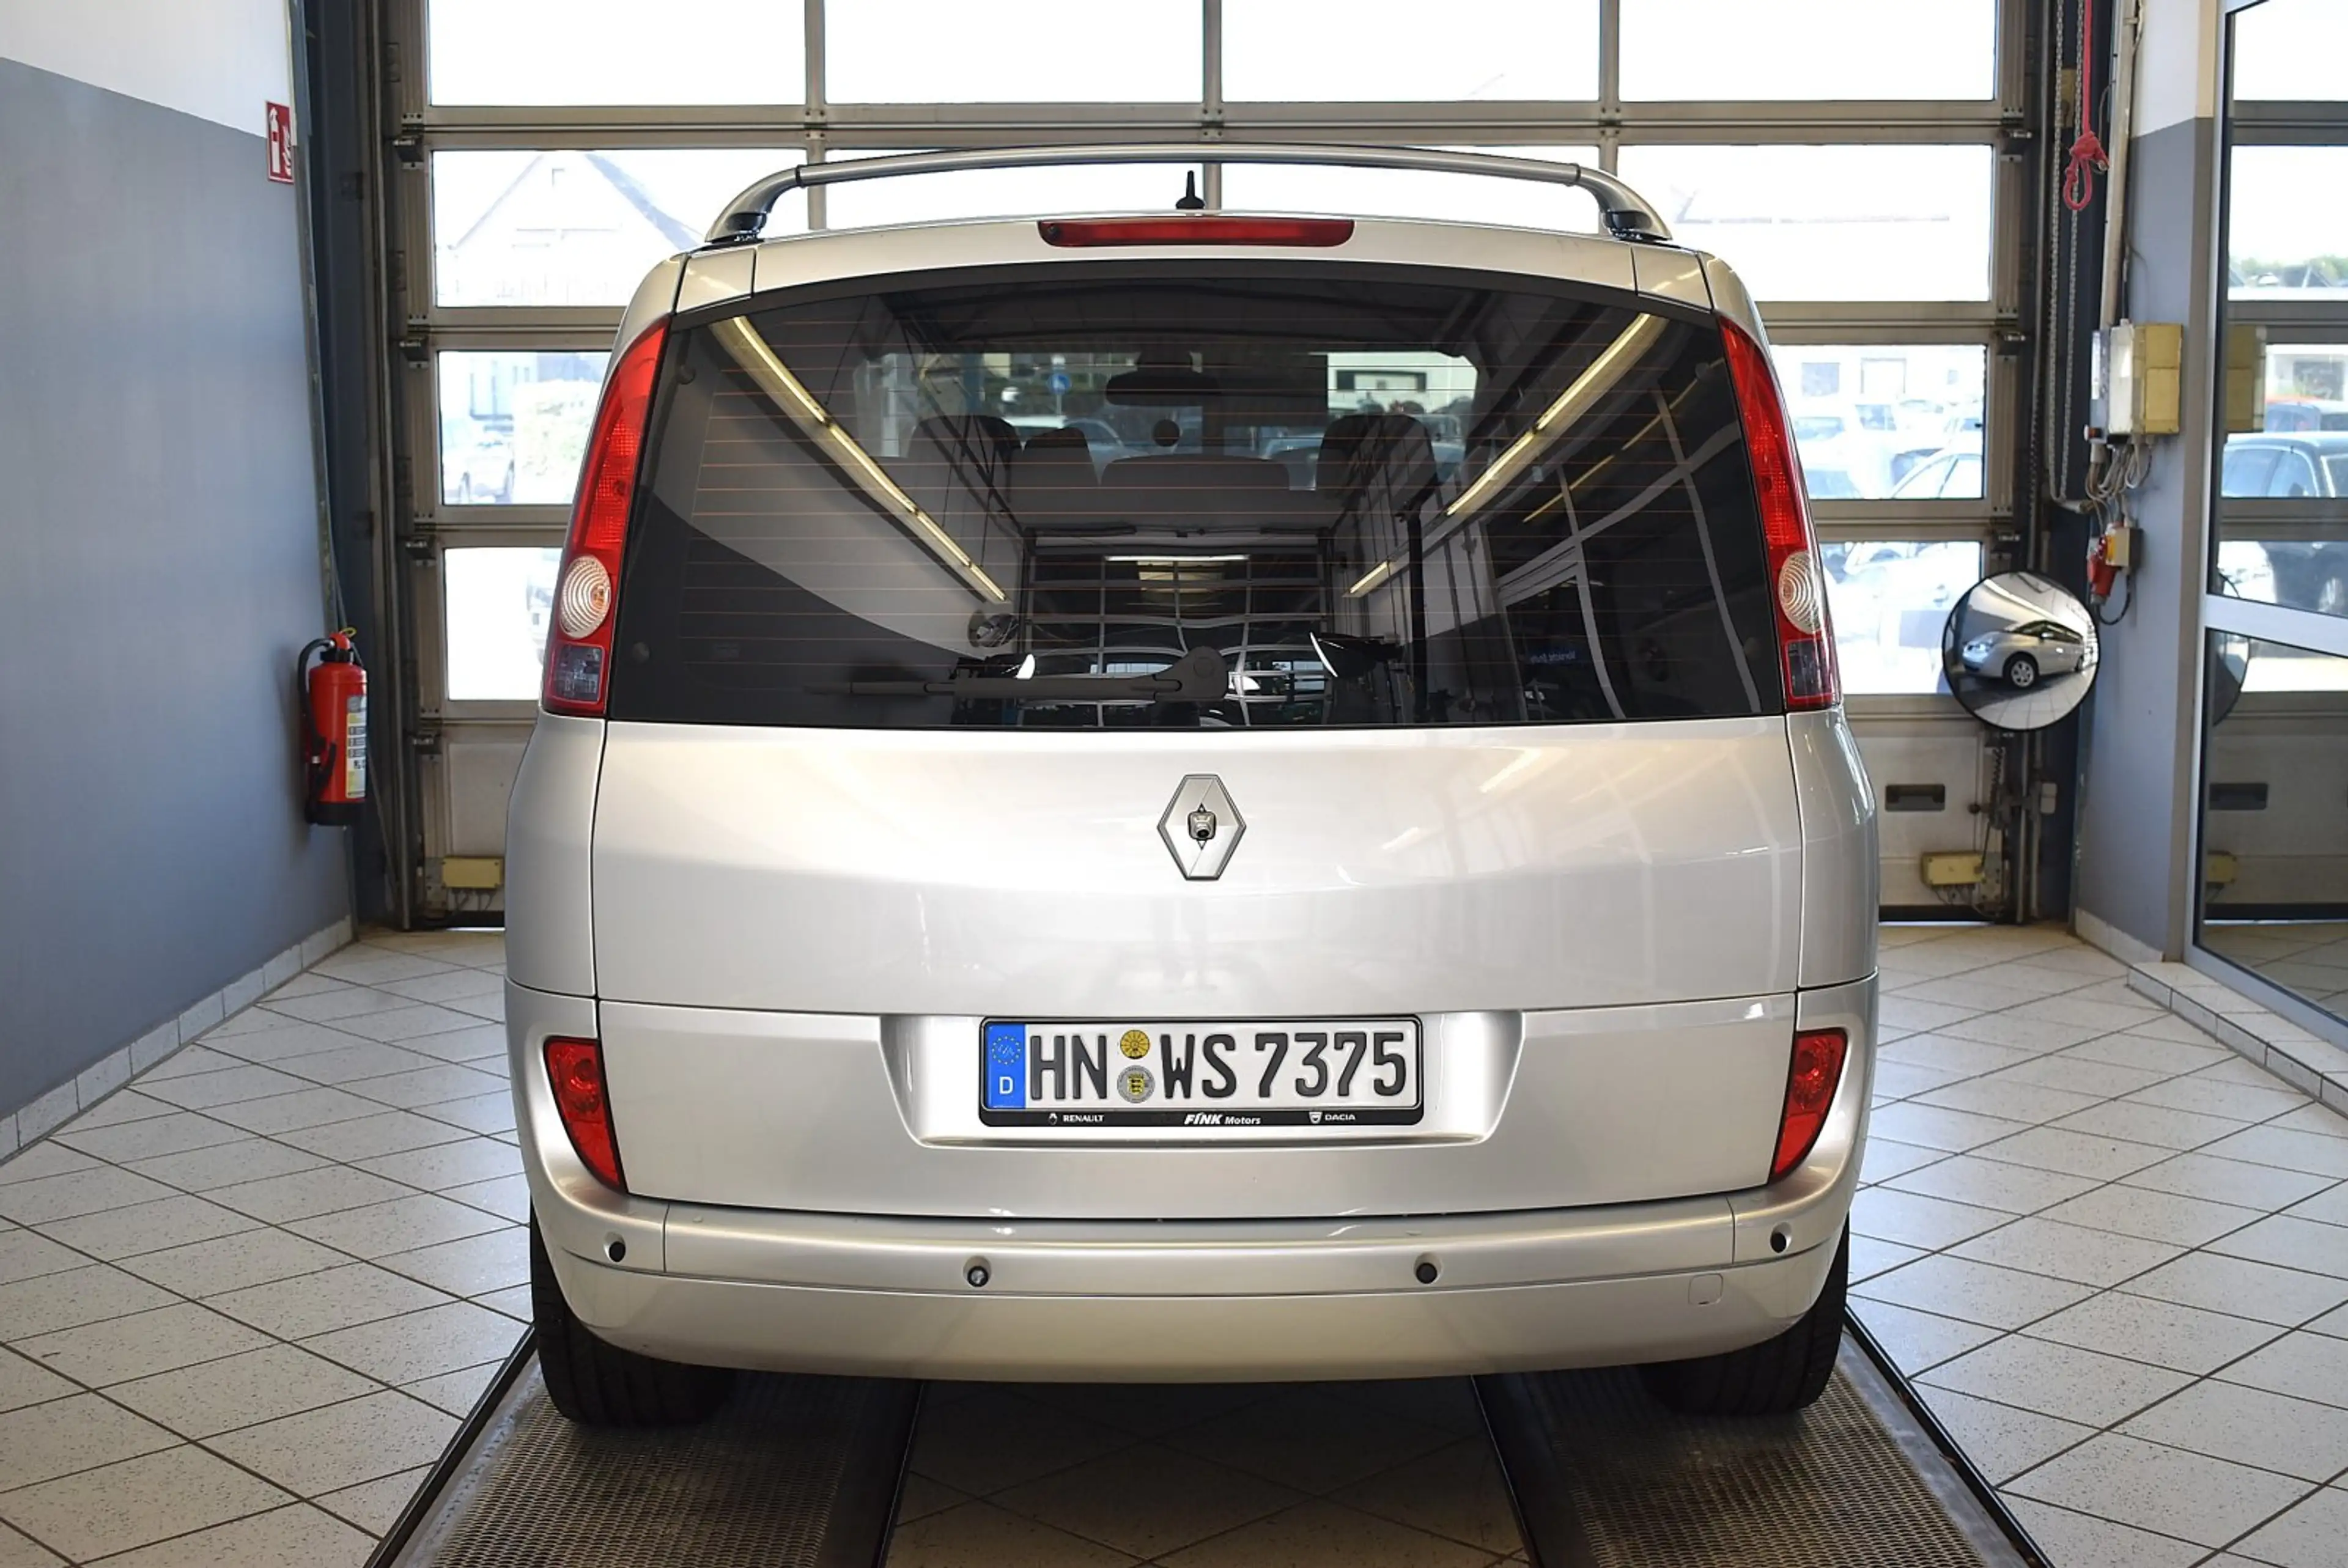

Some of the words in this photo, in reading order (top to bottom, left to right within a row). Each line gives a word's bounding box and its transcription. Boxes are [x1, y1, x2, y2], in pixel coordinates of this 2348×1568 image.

[1030, 1035, 1107, 1100] HN
[1161, 1034, 1238, 1099] WS
[1254, 1032, 1406, 1098] 7375
[999, 1077, 1013, 1094] D
[1224, 1116, 1261, 1125] Motors
